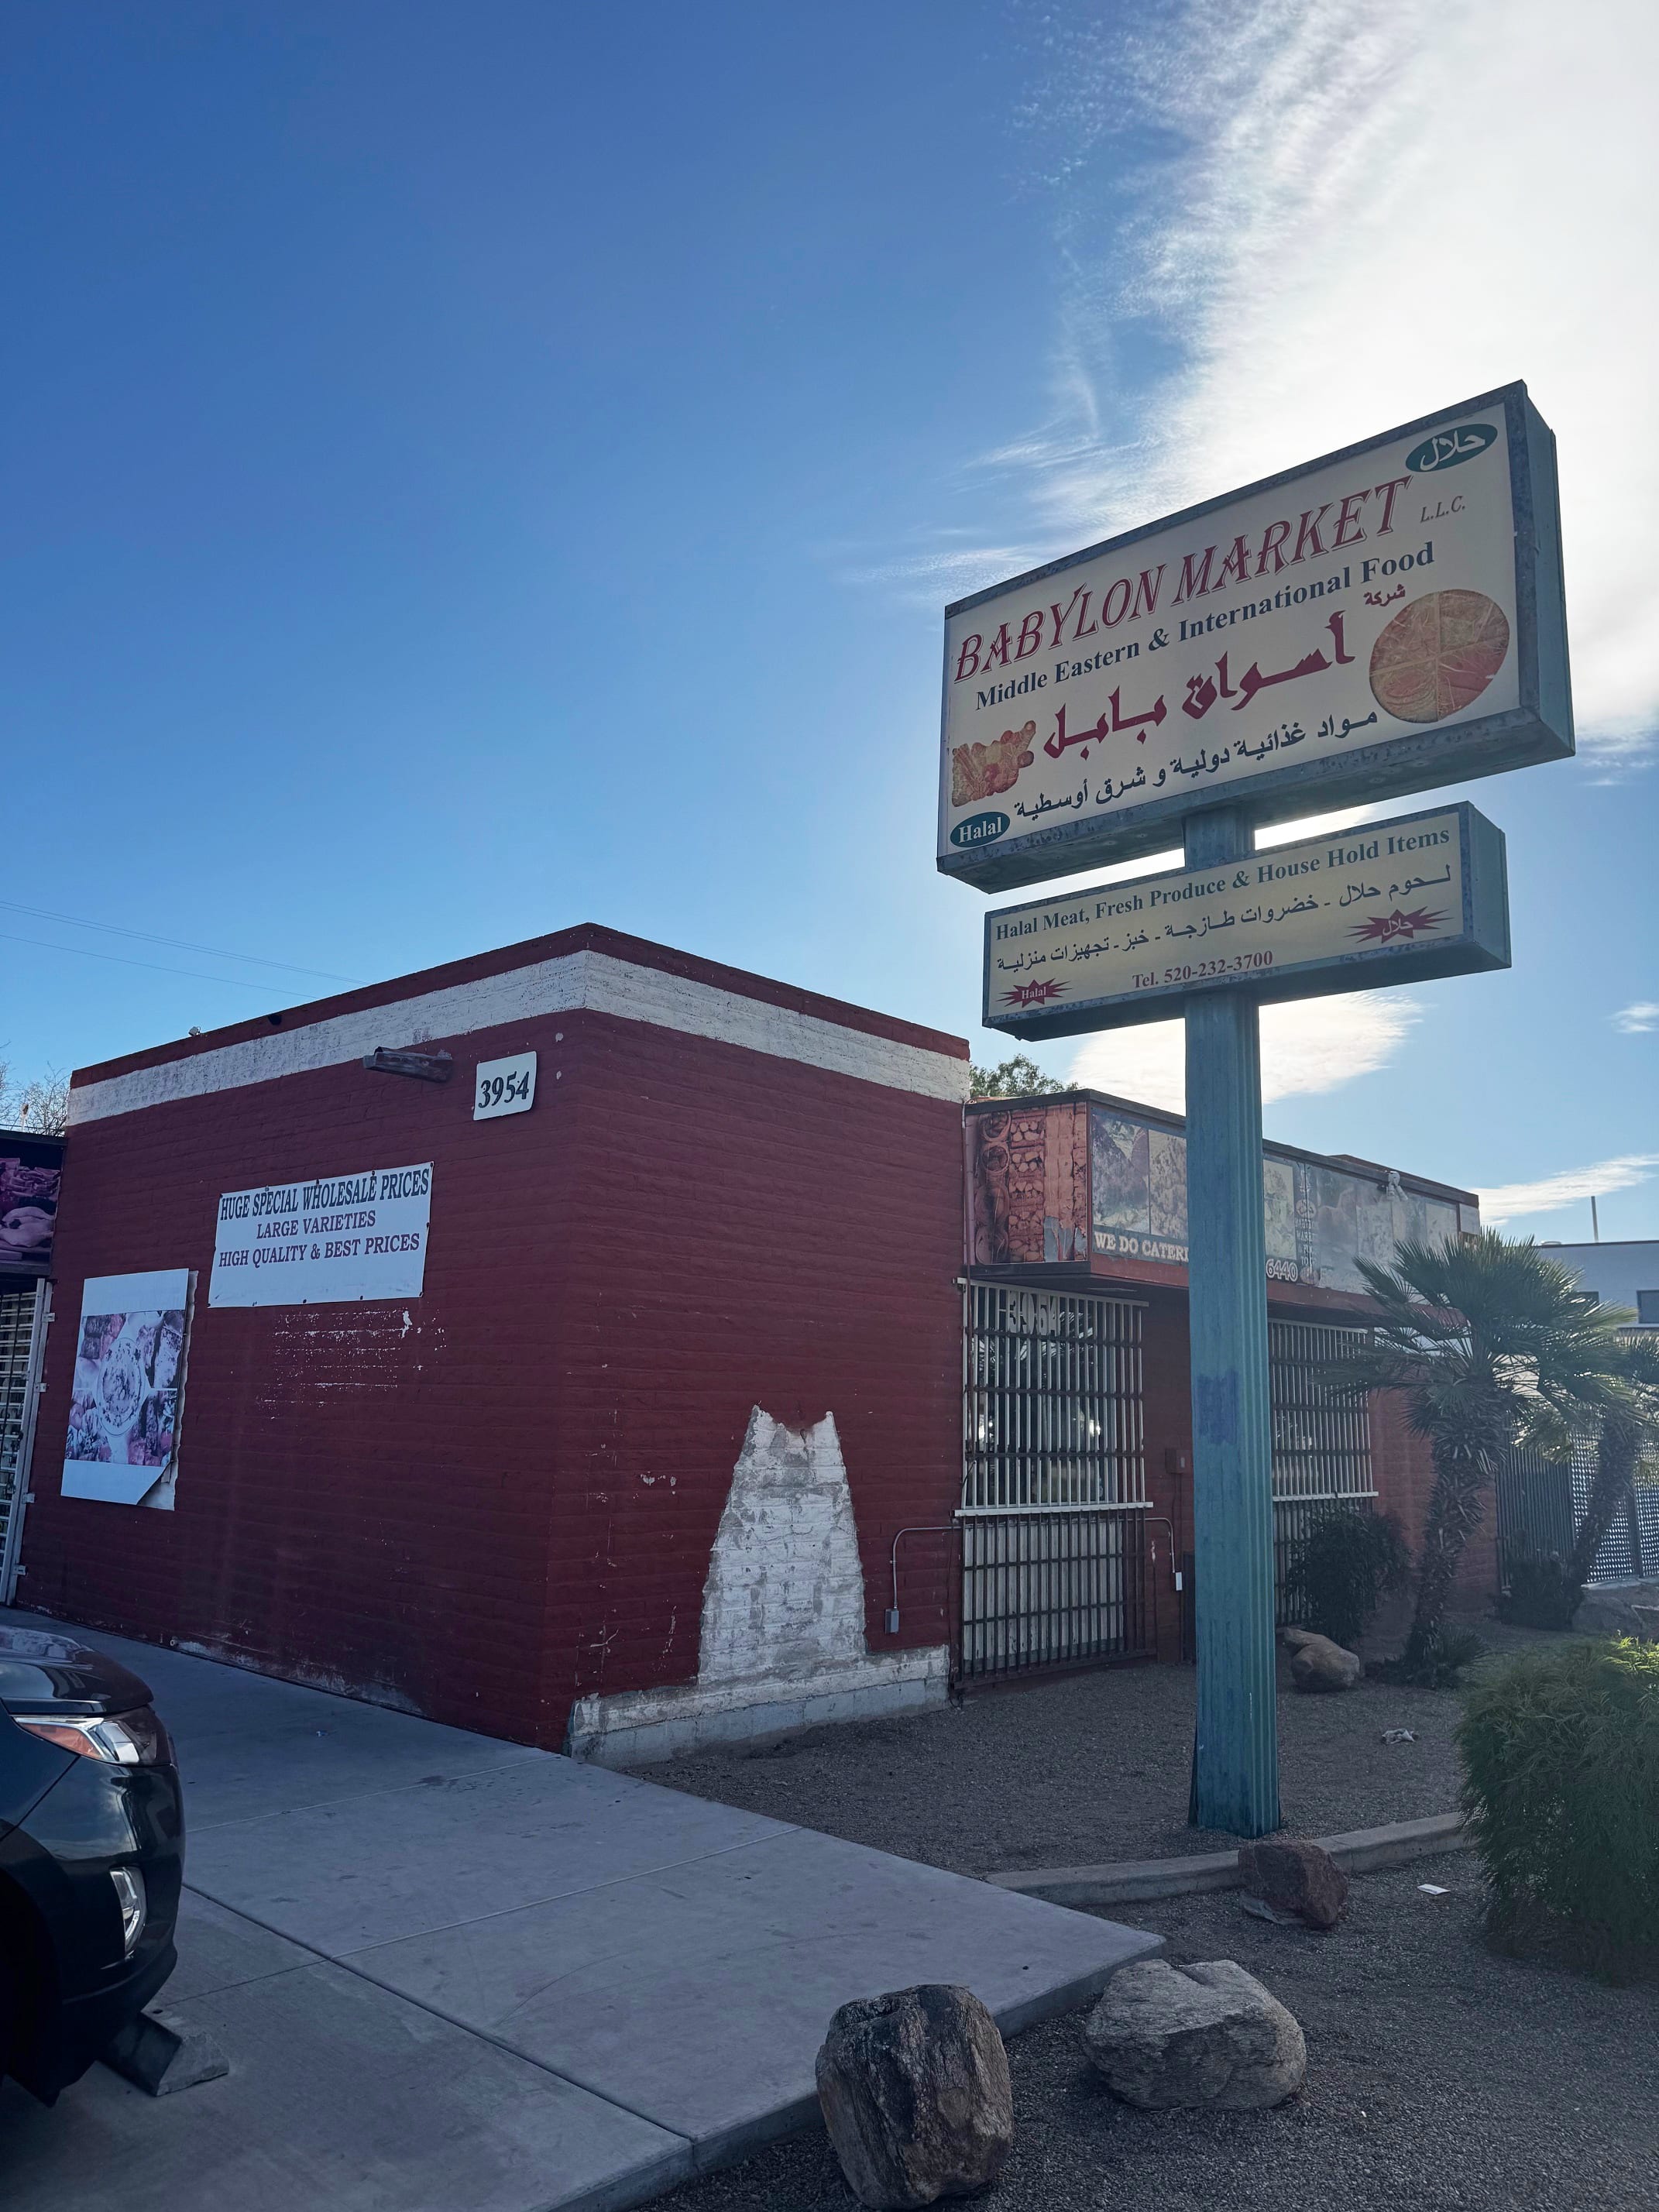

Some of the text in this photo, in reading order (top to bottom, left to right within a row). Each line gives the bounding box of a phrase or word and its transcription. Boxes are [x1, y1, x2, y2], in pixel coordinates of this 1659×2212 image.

[1420, 430, 1486, 471] حلال
[1420, 496, 1465, 524] L.L.C.
[954, 475, 1413, 684] BABYLON MARKET
[1363, 583, 1406, 607] شركة
[975, 541, 1434, 710] Middle Eastern & International Food
[1043, 685, 1167, 761] بابل
[1317, 711, 1378, 738] مواد
[1234, 722, 1306, 761] غذائية
[1170, 748, 1230, 779] دولية
[1014, 778, 1089, 821] أوسطية
[1096, 766, 1146, 804] شرق
[959, 817, 1002, 843] Halal
[996, 829, 1450, 940] Halal Meat, Fresh Produce & House Hold Items
[1339, 881, 1381, 907] حلال
[1389, 864, 1451, 902] لحوم
[1164, 909, 1235, 939] طازجة
[1241, 892, 1318, 924] خضروات
[1122, 929, 1149, 951] خبز
[1382, 917, 1413, 936] حلال
[997, 953, 1046, 974] منزلية
[1050, 936, 1110, 962] تجهيزات
[1132, 950, 1273, 989] Tel. 520-232-3700
[1021, 986, 1046, 1001] Halal
[478, 1070, 530, 1108] 3954
[220, 1168, 430, 1221] HUGE SPECIAL WHOLESALE PRICES
[256, 1210, 376, 1239] LARGE VARIETIES
[218, 1232, 420, 1269] HIGH QUALITY & BEST PRICES
[1094, 1231, 1189, 1263] WE DO CATERI
